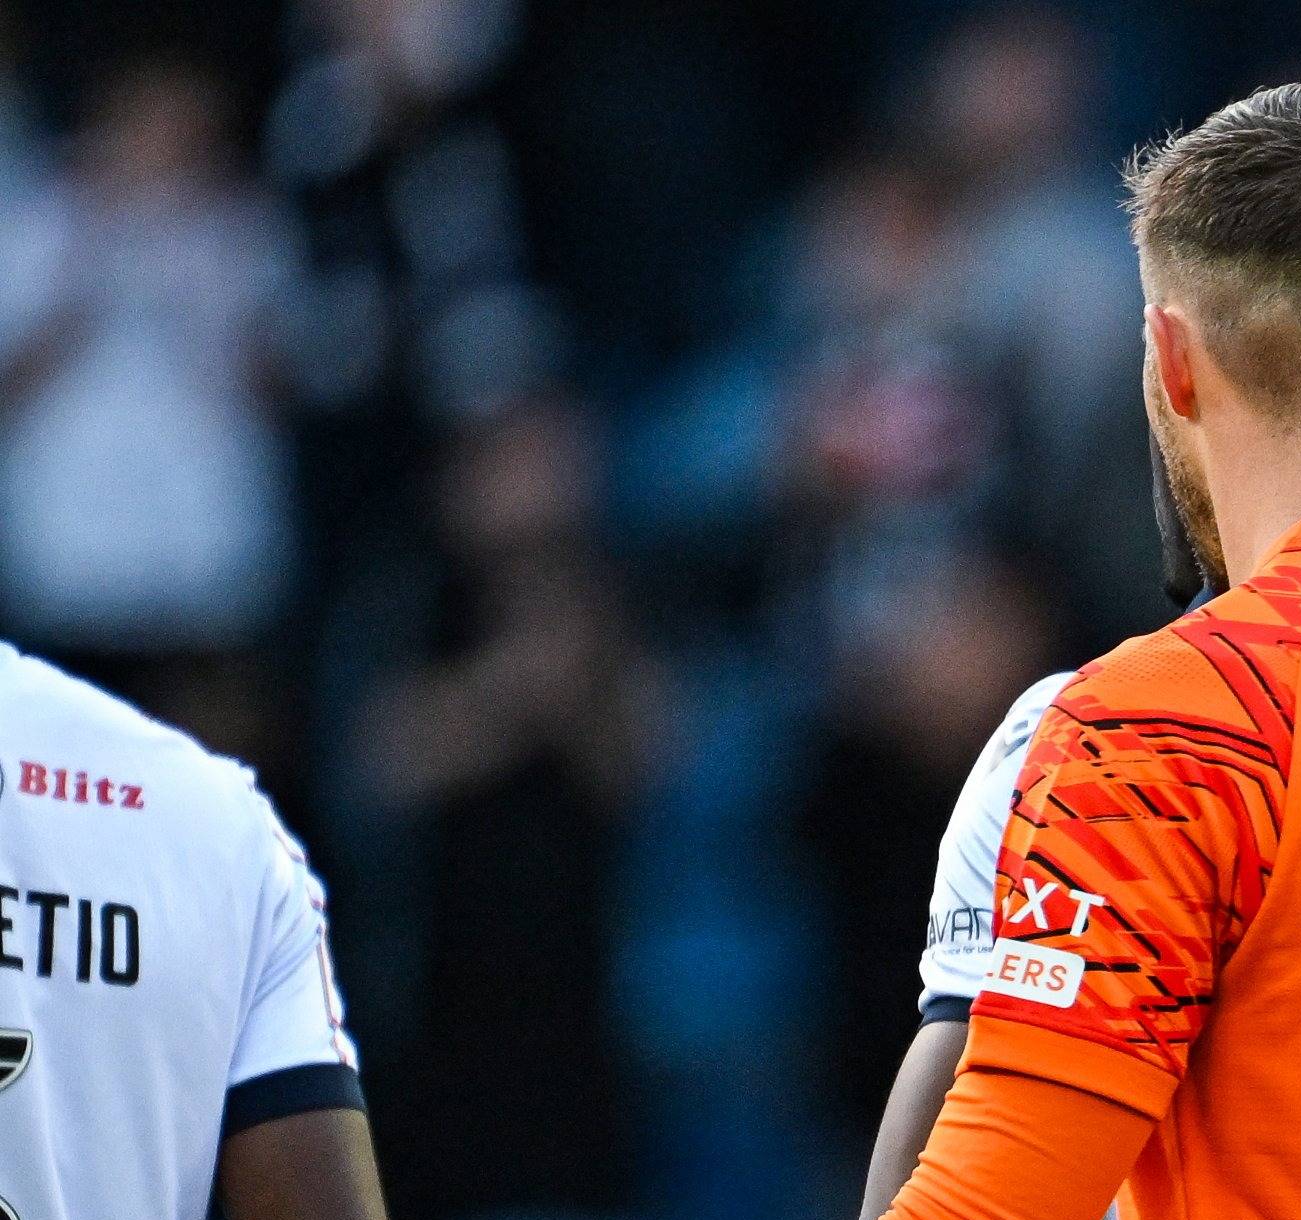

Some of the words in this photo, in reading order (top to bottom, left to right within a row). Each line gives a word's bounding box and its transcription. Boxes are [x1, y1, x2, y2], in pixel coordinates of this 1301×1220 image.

[19, 760, 145, 809] Blitz
[1002, 877, 1106, 938] XT
[0, 884, 140, 987] ETIO
[986, 954, 1068, 992] ERS
